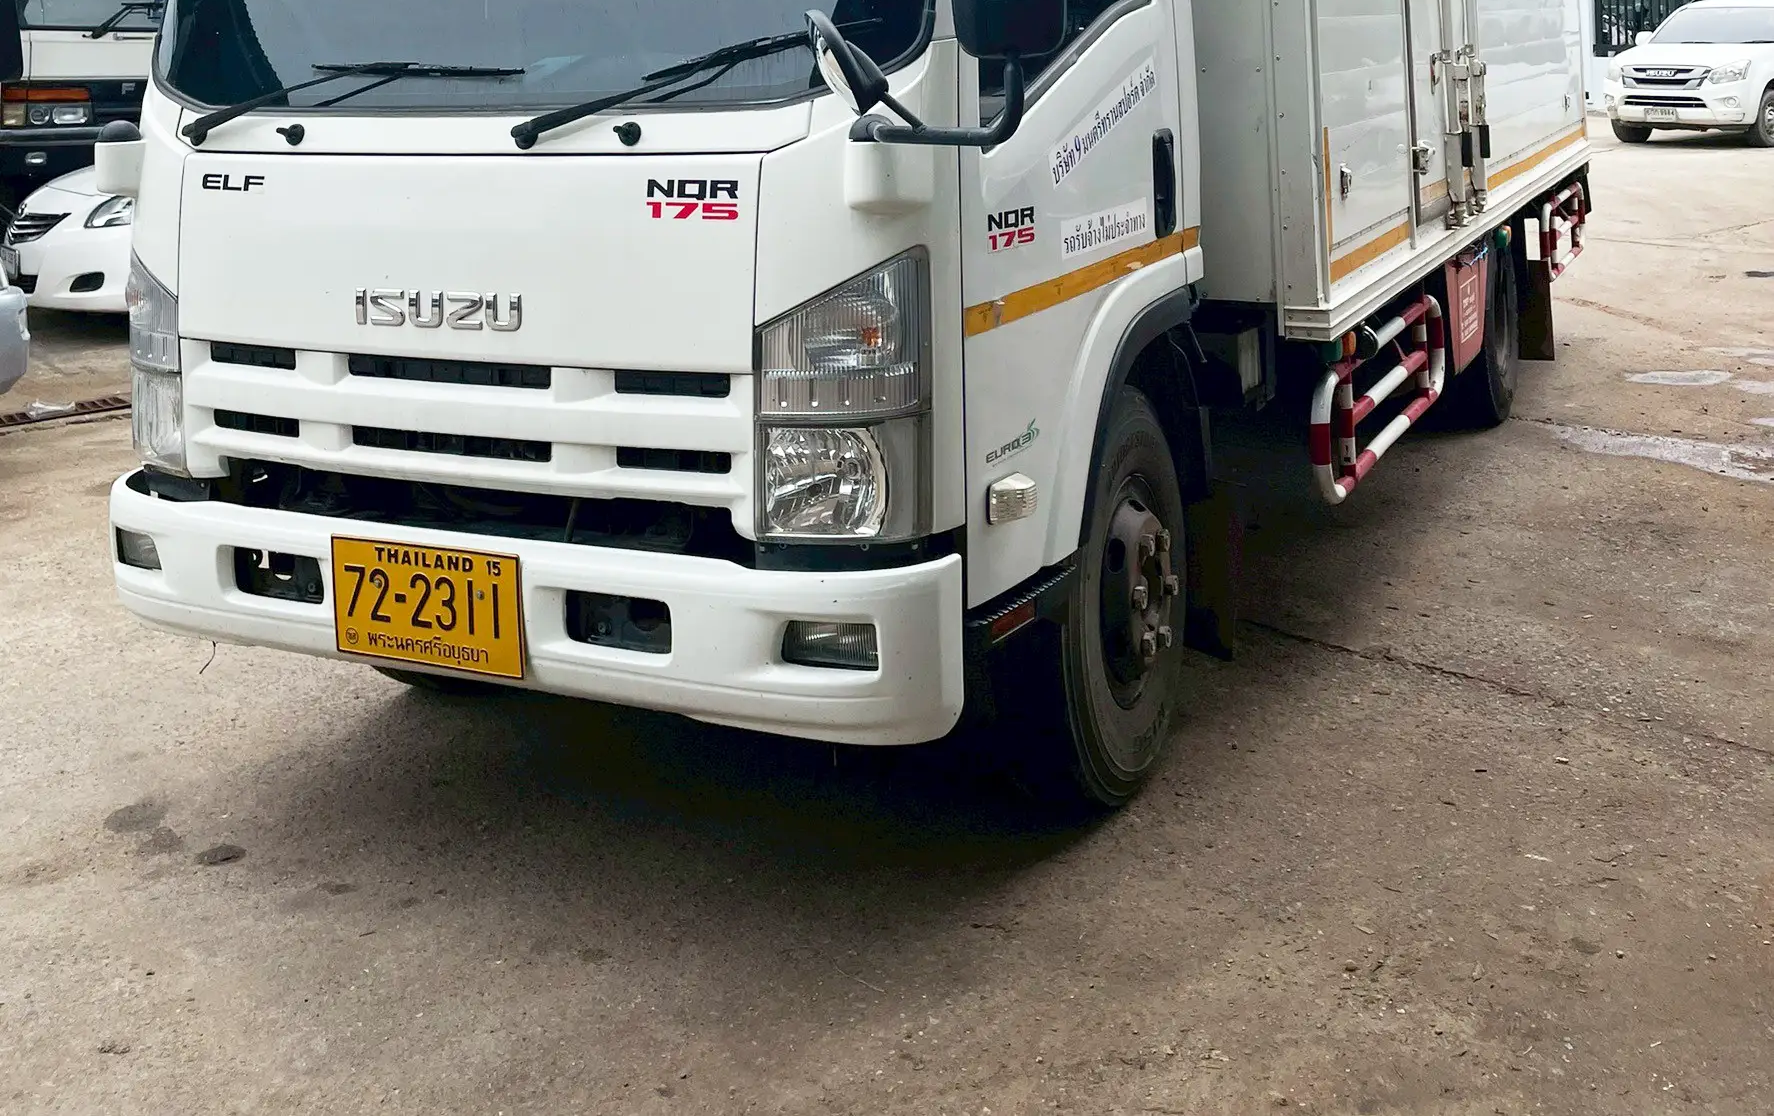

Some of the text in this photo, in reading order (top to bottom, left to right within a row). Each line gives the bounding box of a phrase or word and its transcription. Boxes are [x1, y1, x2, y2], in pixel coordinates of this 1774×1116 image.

[202, 174, 265, 191] ELF
[646, 179, 739, 200] NQR
[646, 201, 739, 220] 175
[987, 206, 1035, 232] NQR
[988, 227, 1035, 251] 175
[355, 287, 522, 332] ISUZU
[374, 546, 502, 577] THAILAND 15
[344, 564, 500, 640] 72-2311
[367, 632, 489, 665] พระนครศรีอยุธยา
